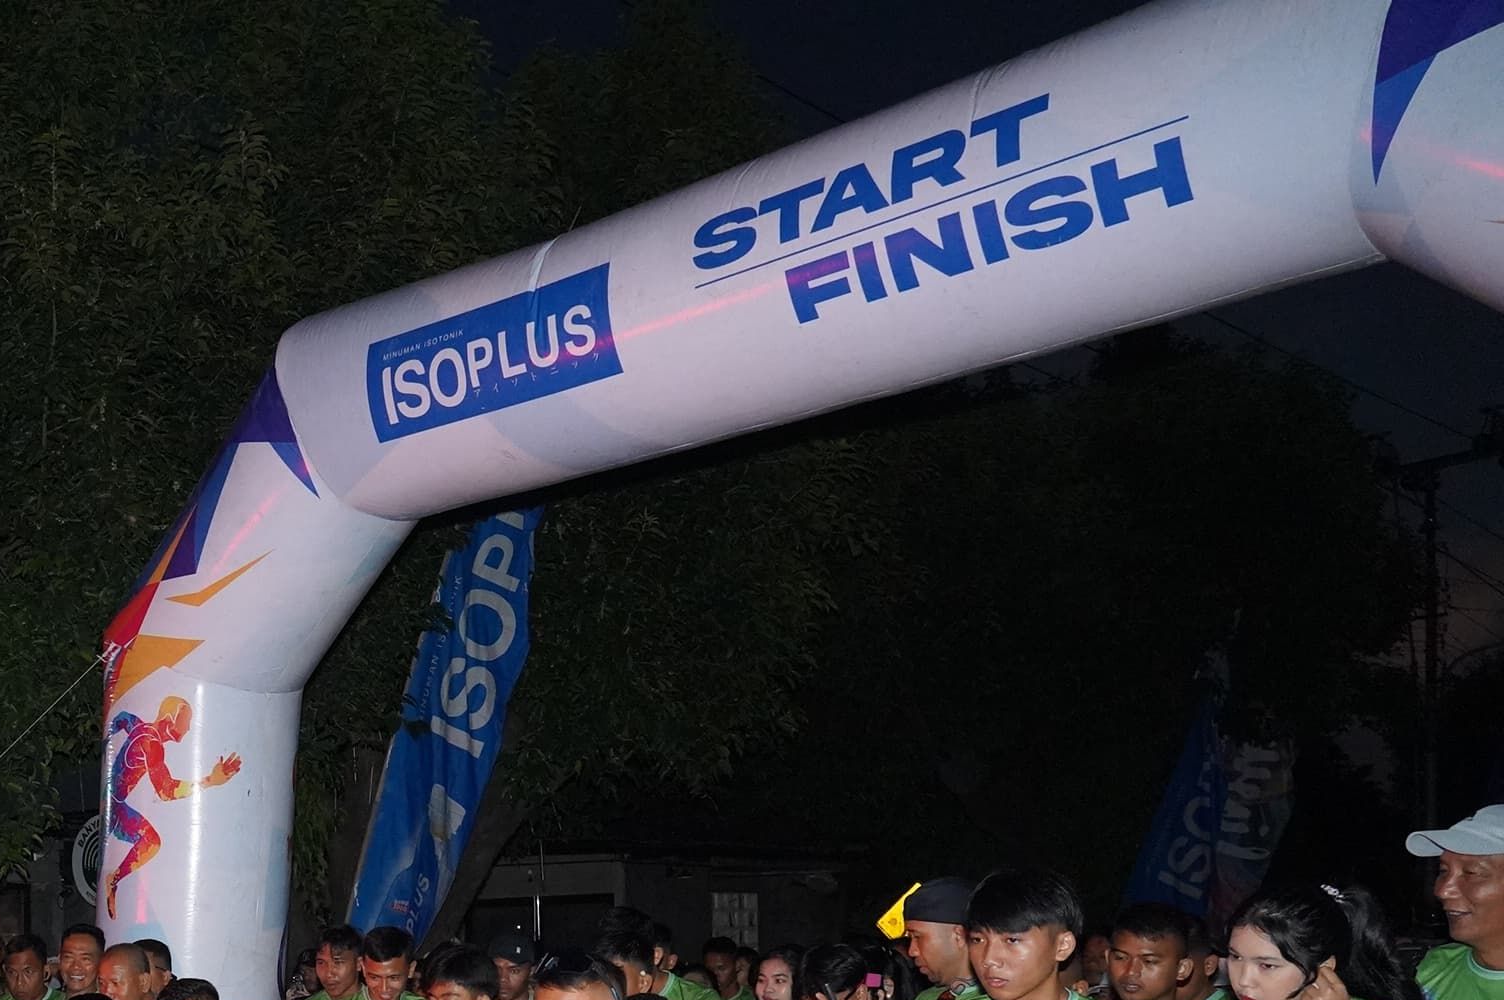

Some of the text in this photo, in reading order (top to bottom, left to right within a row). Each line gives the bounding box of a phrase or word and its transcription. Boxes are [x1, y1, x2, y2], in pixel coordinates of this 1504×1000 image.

[693, 93, 1051, 270] START
[786, 135, 1195, 324] FINISH
[382, 328, 464, 361] MINUMAN ISOTONIK
[382, 304, 597, 426] ISOPLUS
[431, 506, 527, 759] ISOP
